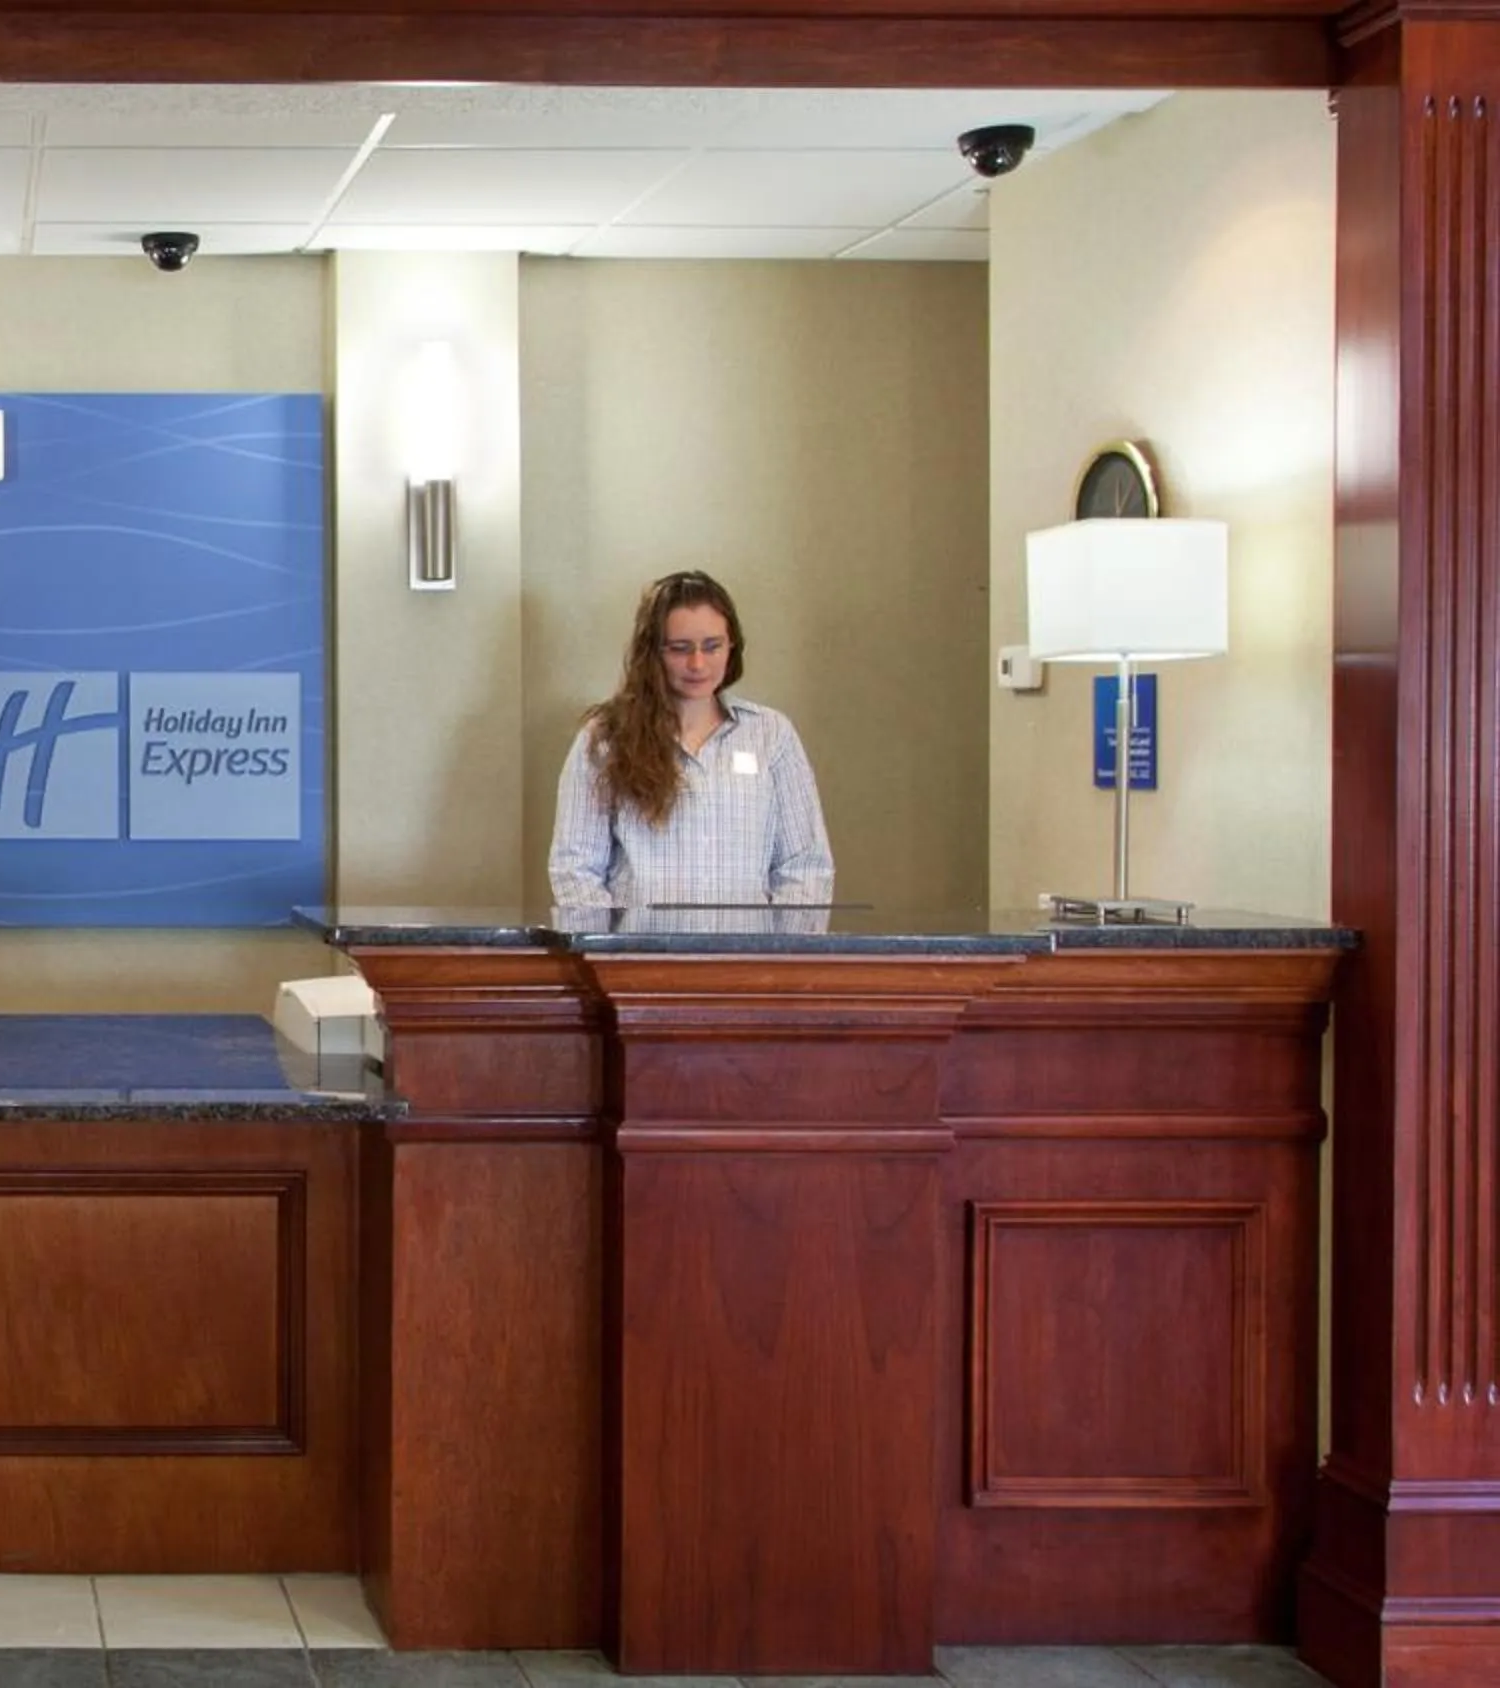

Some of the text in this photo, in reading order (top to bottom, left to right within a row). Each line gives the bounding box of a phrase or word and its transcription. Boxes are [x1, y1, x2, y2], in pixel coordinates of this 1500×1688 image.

[143, 708, 288, 738] Holiday Inn
[140, 741, 290, 784] Express
